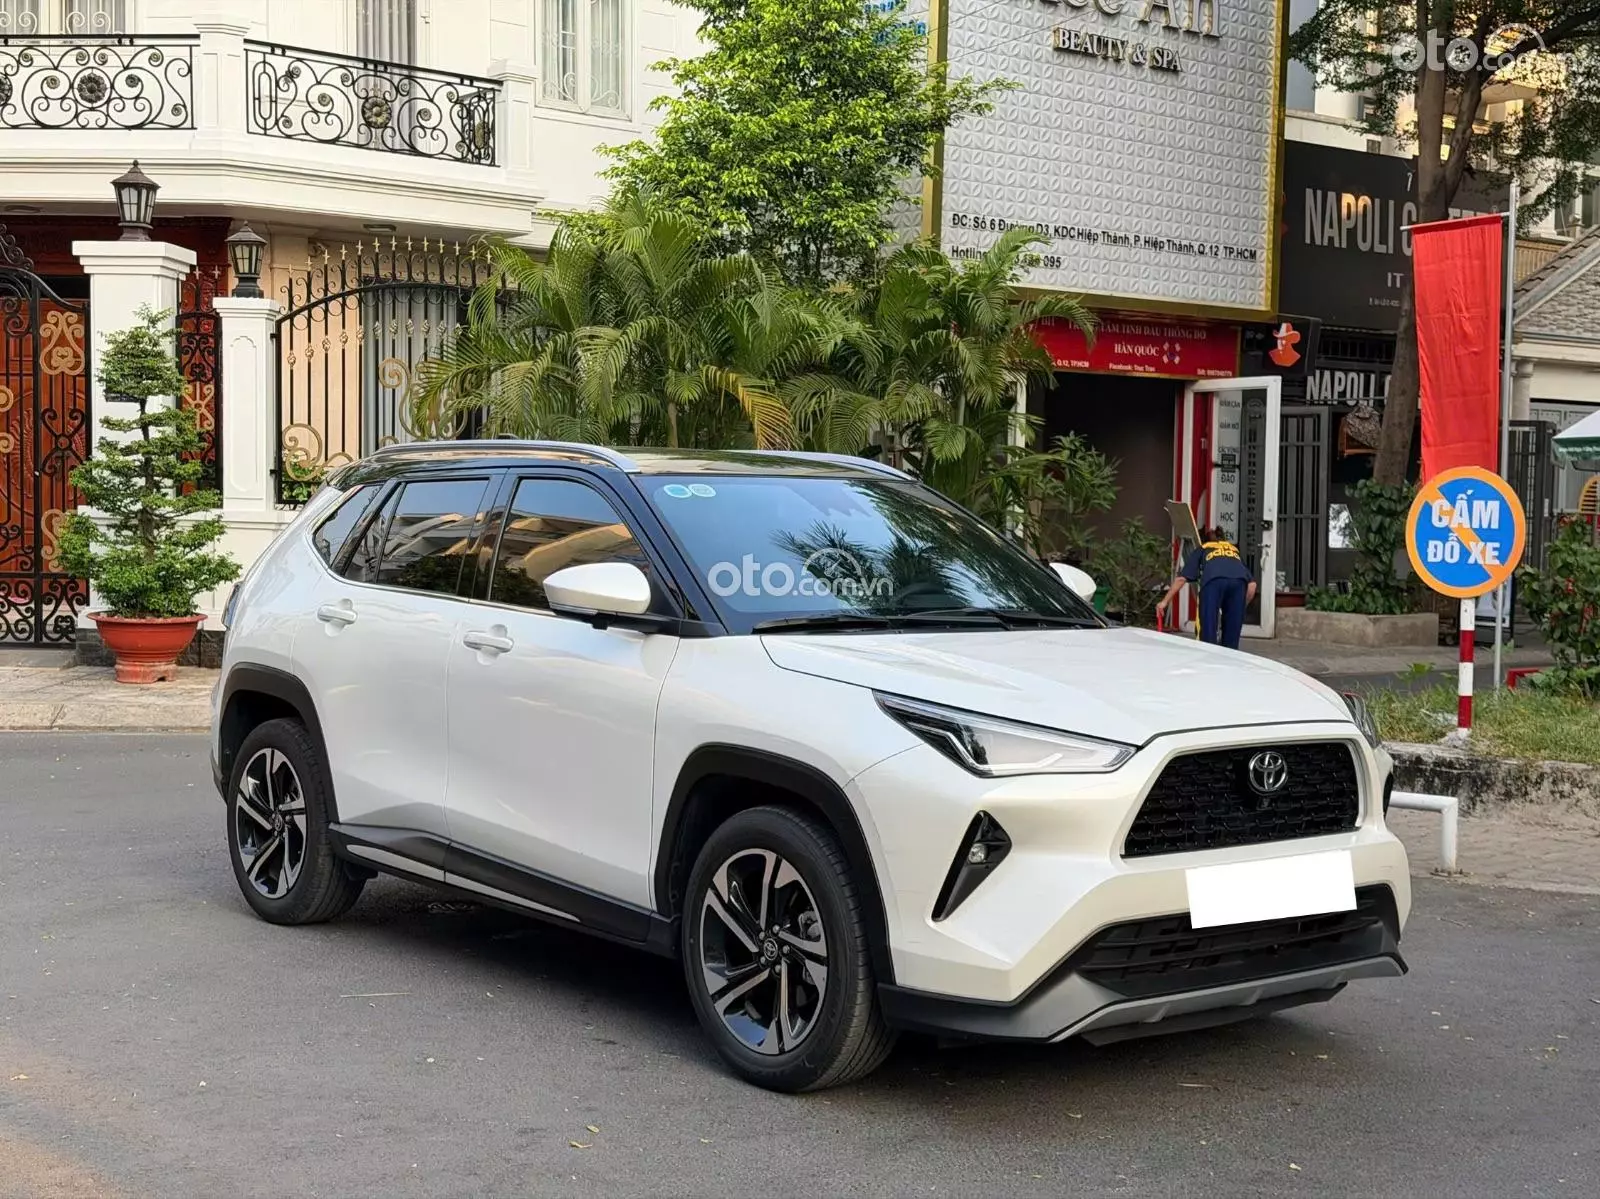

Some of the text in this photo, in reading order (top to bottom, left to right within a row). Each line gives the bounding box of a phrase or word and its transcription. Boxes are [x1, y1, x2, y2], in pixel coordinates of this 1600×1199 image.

[1054, 27, 1183, 72] BEAUTY & SPA
[990, 218, 996, 231] 6
[1054, 225, 1076, 239] KDC
[1077, 230, 1099, 244] Hiệp
[1223, 246, 1257, 260] TP.HCM
[1305, 188, 1394, 254] NAPOLI
[1043, 255, 1061, 268] 095
[1114, 342, 1160, 357] HÀN QUỐC
[1306, 369, 1375, 407] NAPOLI
[1431, 489, 1500, 529] CẤM
[1205, 548, 1241, 561] adida
[1467, 541, 1501, 565] XE
